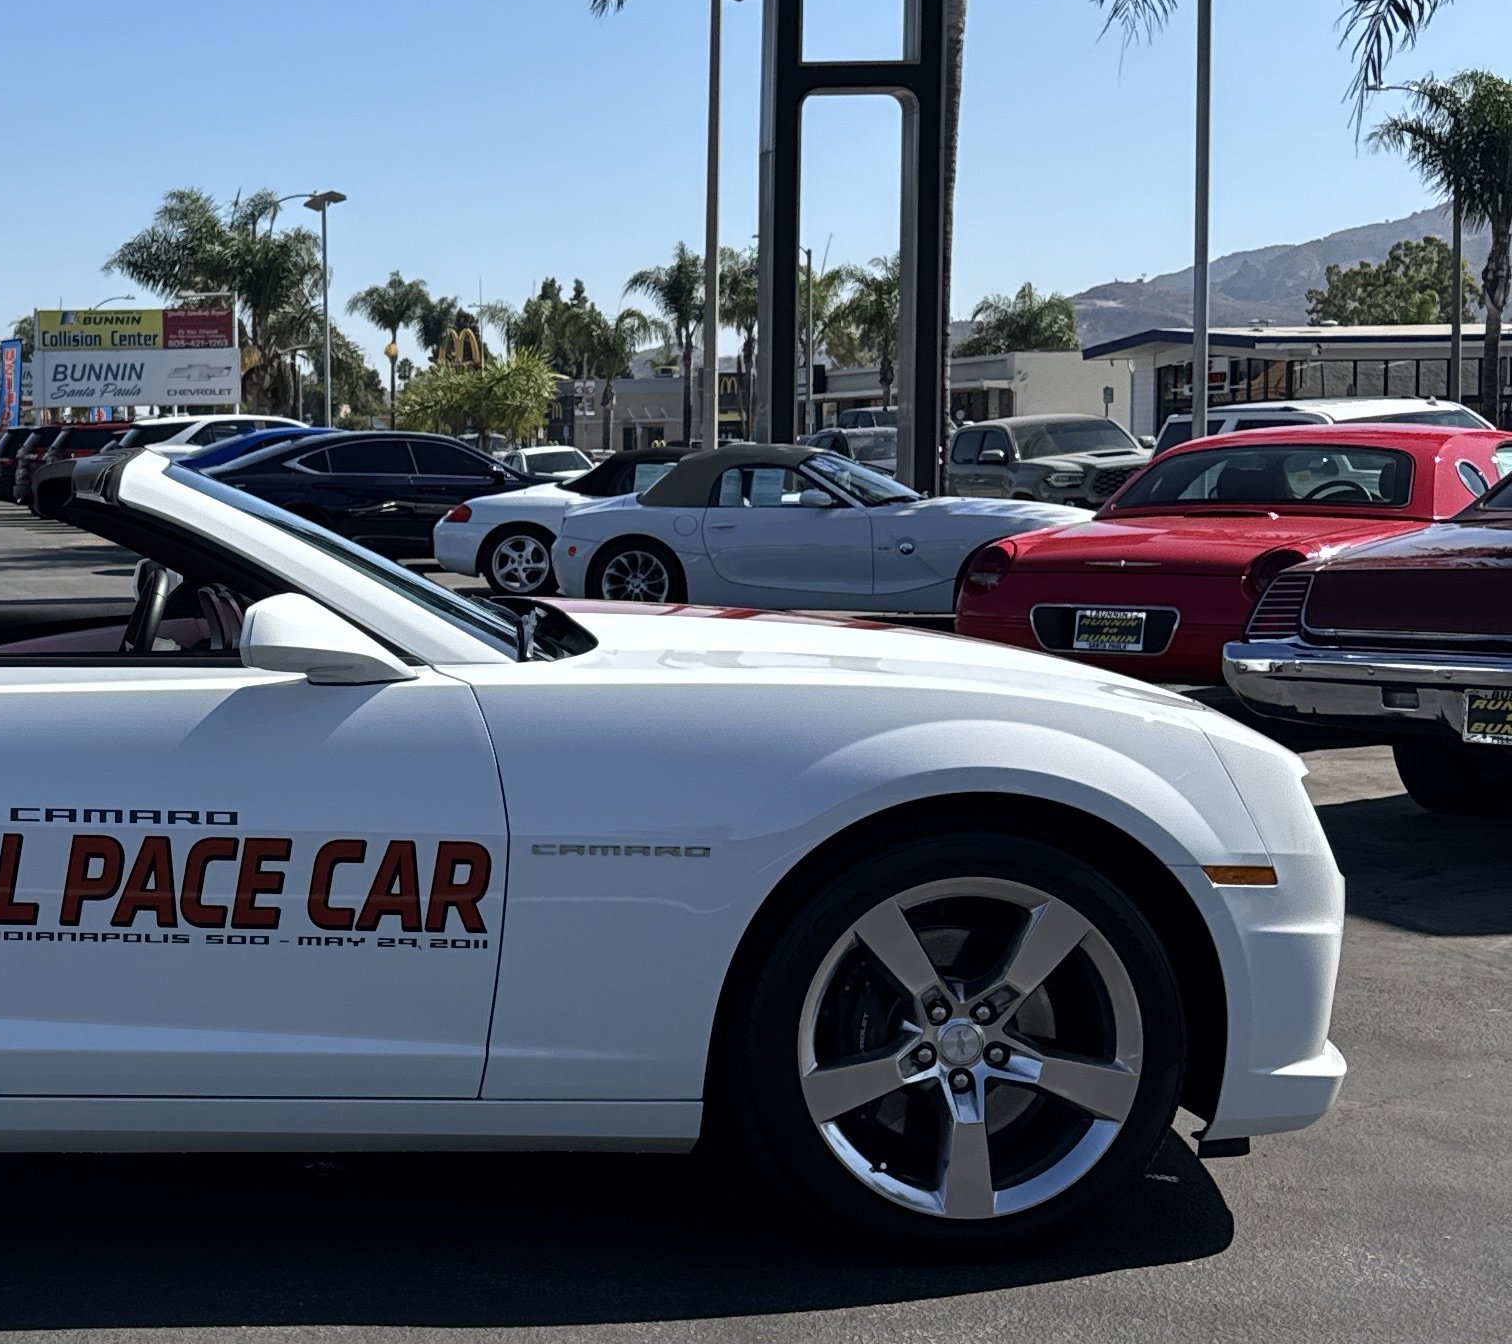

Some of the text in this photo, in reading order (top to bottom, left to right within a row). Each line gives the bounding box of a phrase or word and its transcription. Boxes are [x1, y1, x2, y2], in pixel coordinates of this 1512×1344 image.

[82, 316, 142, 326] BUNNIN
[42, 331, 102, 347] Collision
[111, 331, 159, 347] Center
[52, 363, 145, 382] BUNNIN
[50, 384, 96, 400] Santa
[100, 383, 142, 399] Paula
[167, 388, 233, 396] CHEVROLET
[1078, 633, 1137, 643] BUNNIN
[10, 807, 238, 825] CAMARO
[532, 844, 711, 858] CAMARO
[59, 834, 293, 930] PACE
[307, 838, 492, 933] CAR
[205, 935, 270, 945] 500
[297, 936, 366, 947] MAY
[377, 937, 422, 950] 29,
[430, 939, 488, 949] 2011
